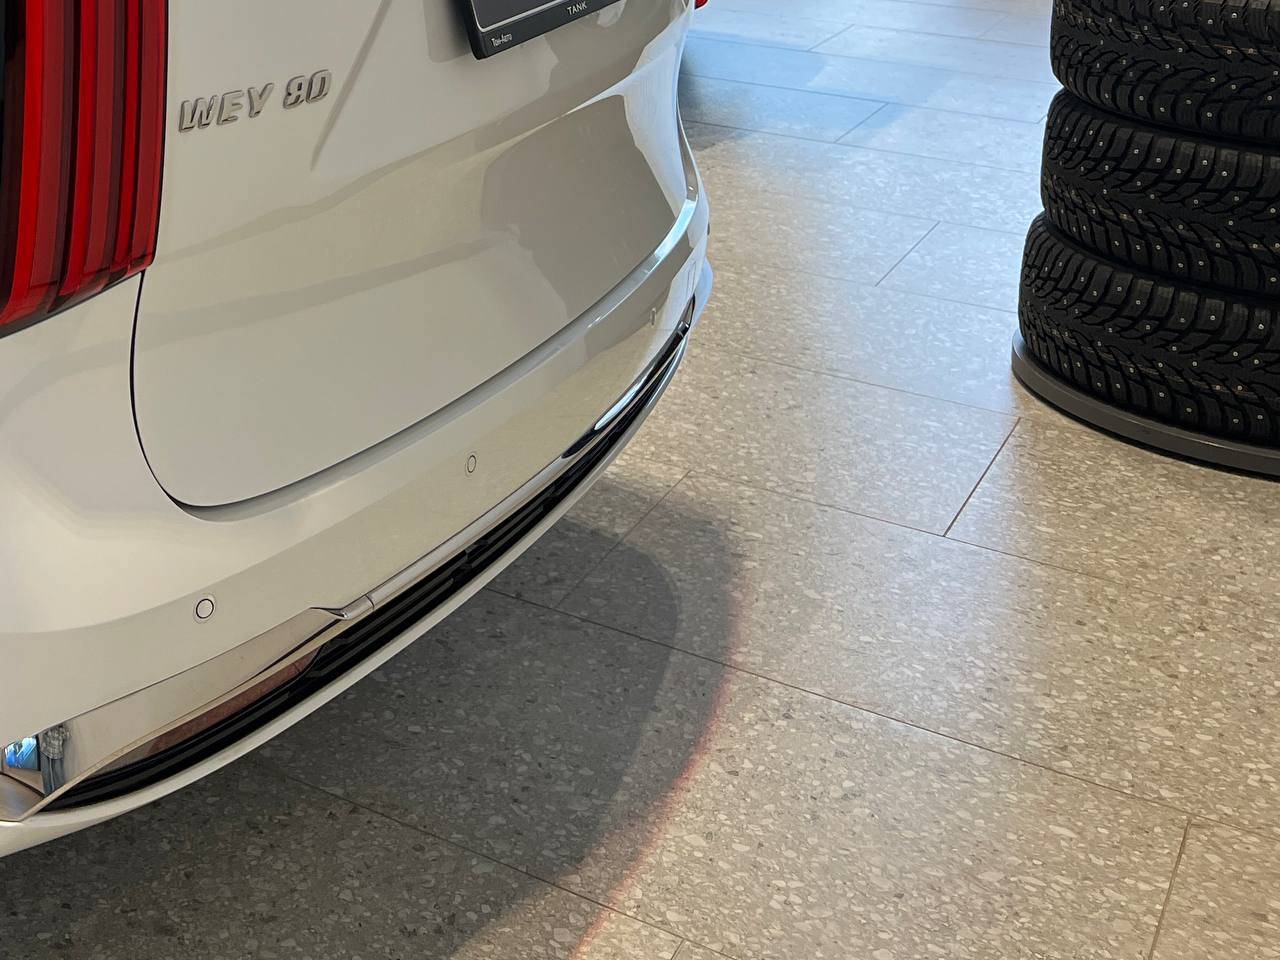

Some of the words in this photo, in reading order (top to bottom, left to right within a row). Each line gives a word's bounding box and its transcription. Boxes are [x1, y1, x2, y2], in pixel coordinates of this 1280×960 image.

[567, 1, 587, 16] TANK
[178, 82, 274, 133] WEY
[283, 68, 332, 109] 80
